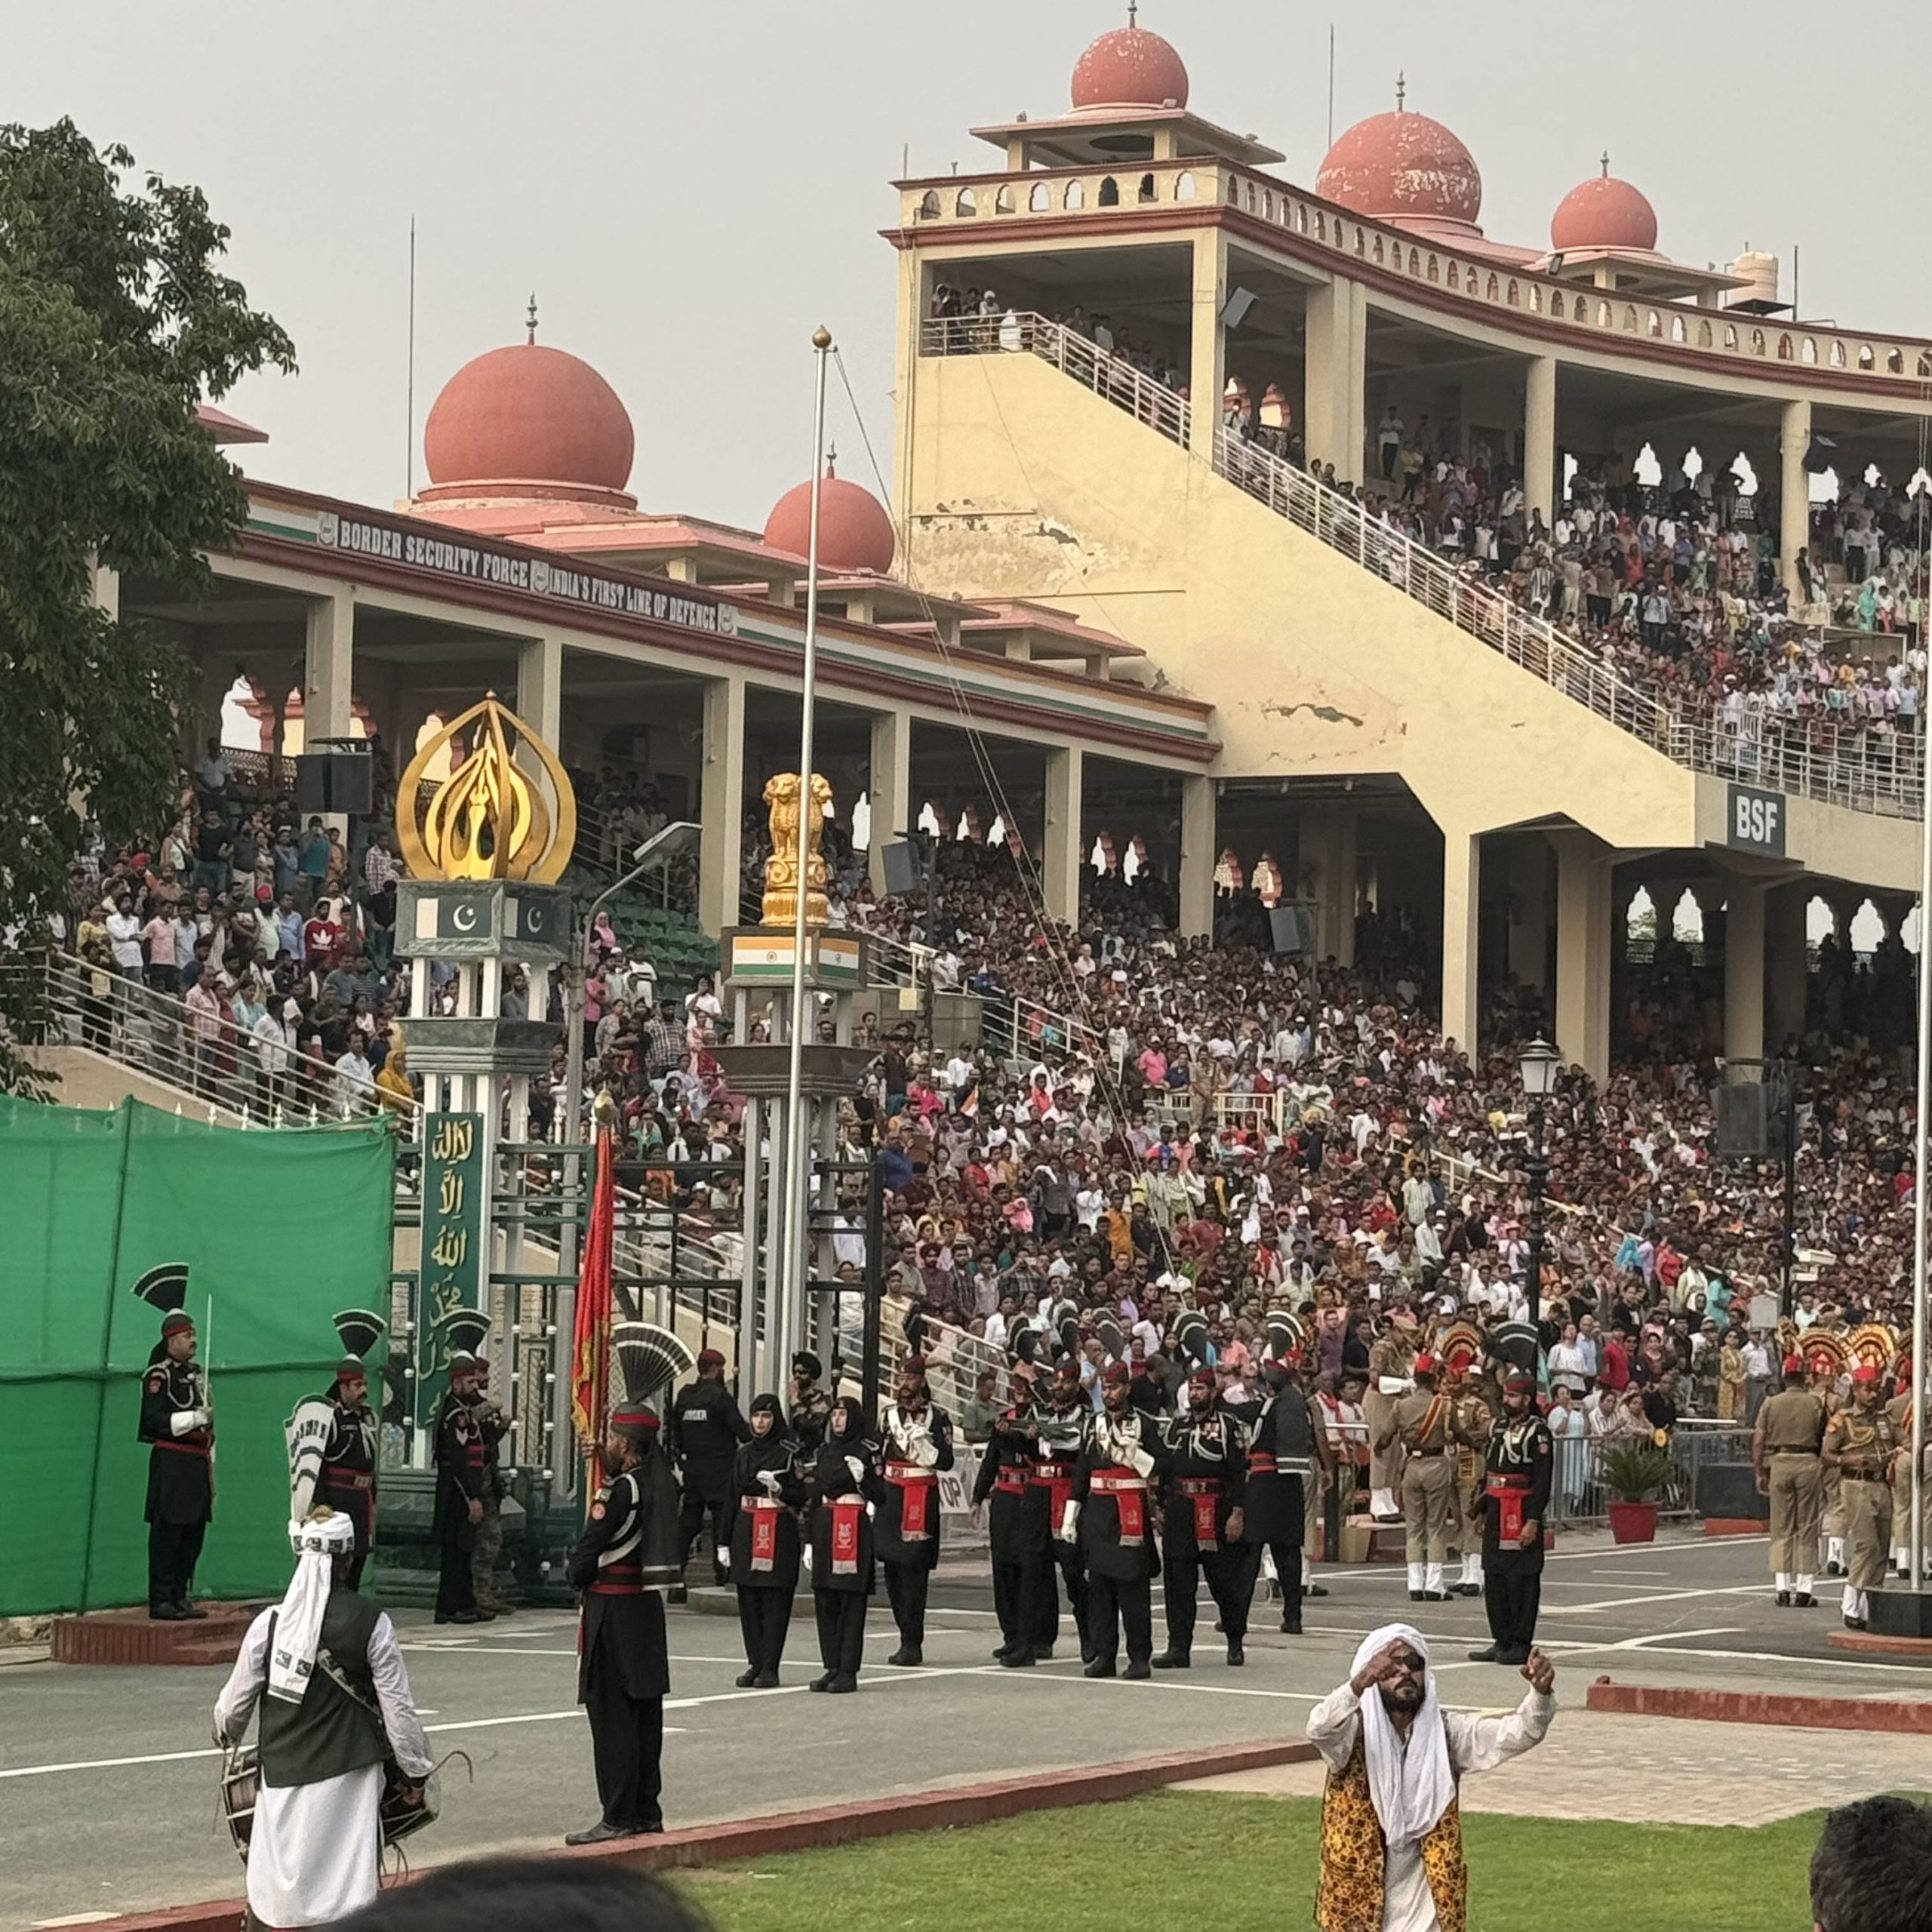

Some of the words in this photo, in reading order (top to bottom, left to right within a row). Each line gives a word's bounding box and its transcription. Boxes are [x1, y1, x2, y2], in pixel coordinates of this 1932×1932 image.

[340, 520, 401, 558] BORDER
[405, 535, 479, 576] SECURITY
[482, 553, 528, 588] FORCE
[550, 567, 589, 601] INDIA'S
[591, 578, 625, 608] FIRST
[626, 587, 652, 617] LINE
[654, 592, 667, 618] OF
[669, 597, 715, 631] DEFENCE
[1736, 795, 1777, 844] BSF
